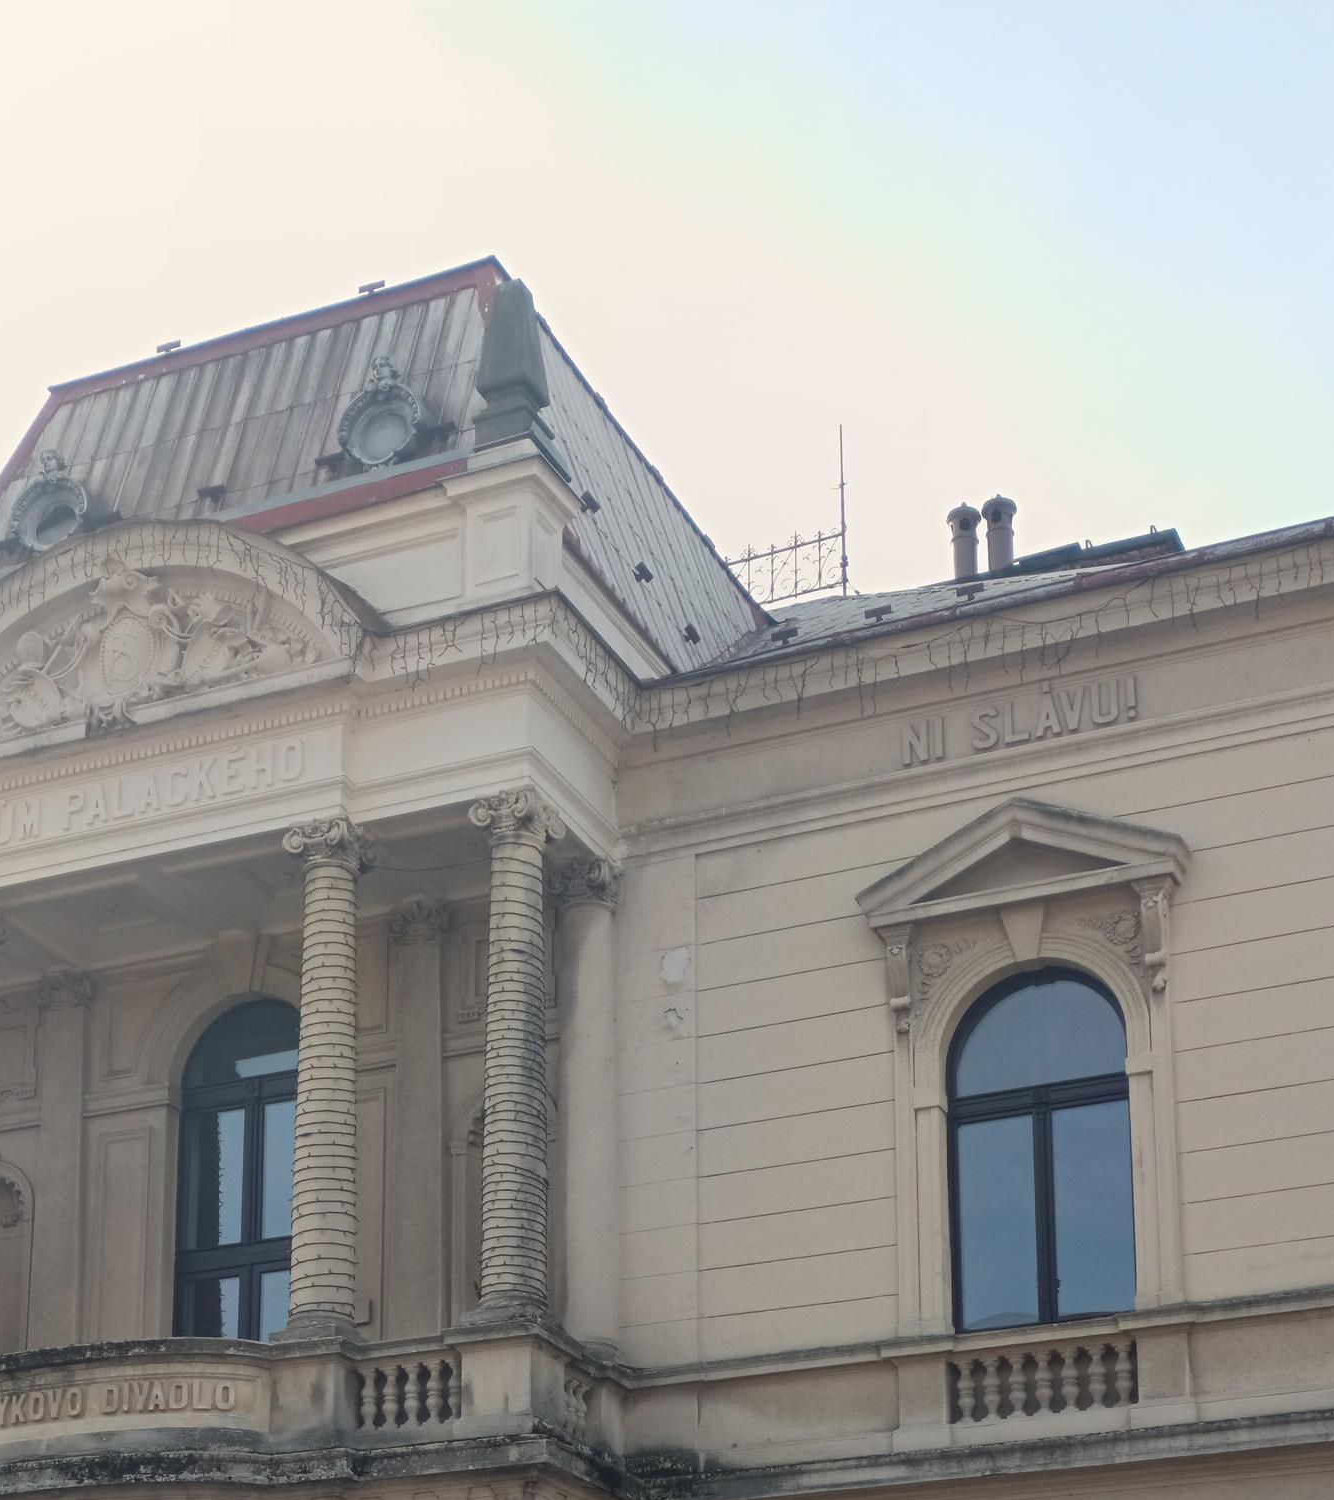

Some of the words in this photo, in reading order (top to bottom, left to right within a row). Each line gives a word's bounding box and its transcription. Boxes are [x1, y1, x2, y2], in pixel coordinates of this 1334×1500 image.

[903, 716, 945, 767] NI
[62, 737, 306, 831] PALACKÉHO
[100, 1378, 237, 1415] DIVADLO
